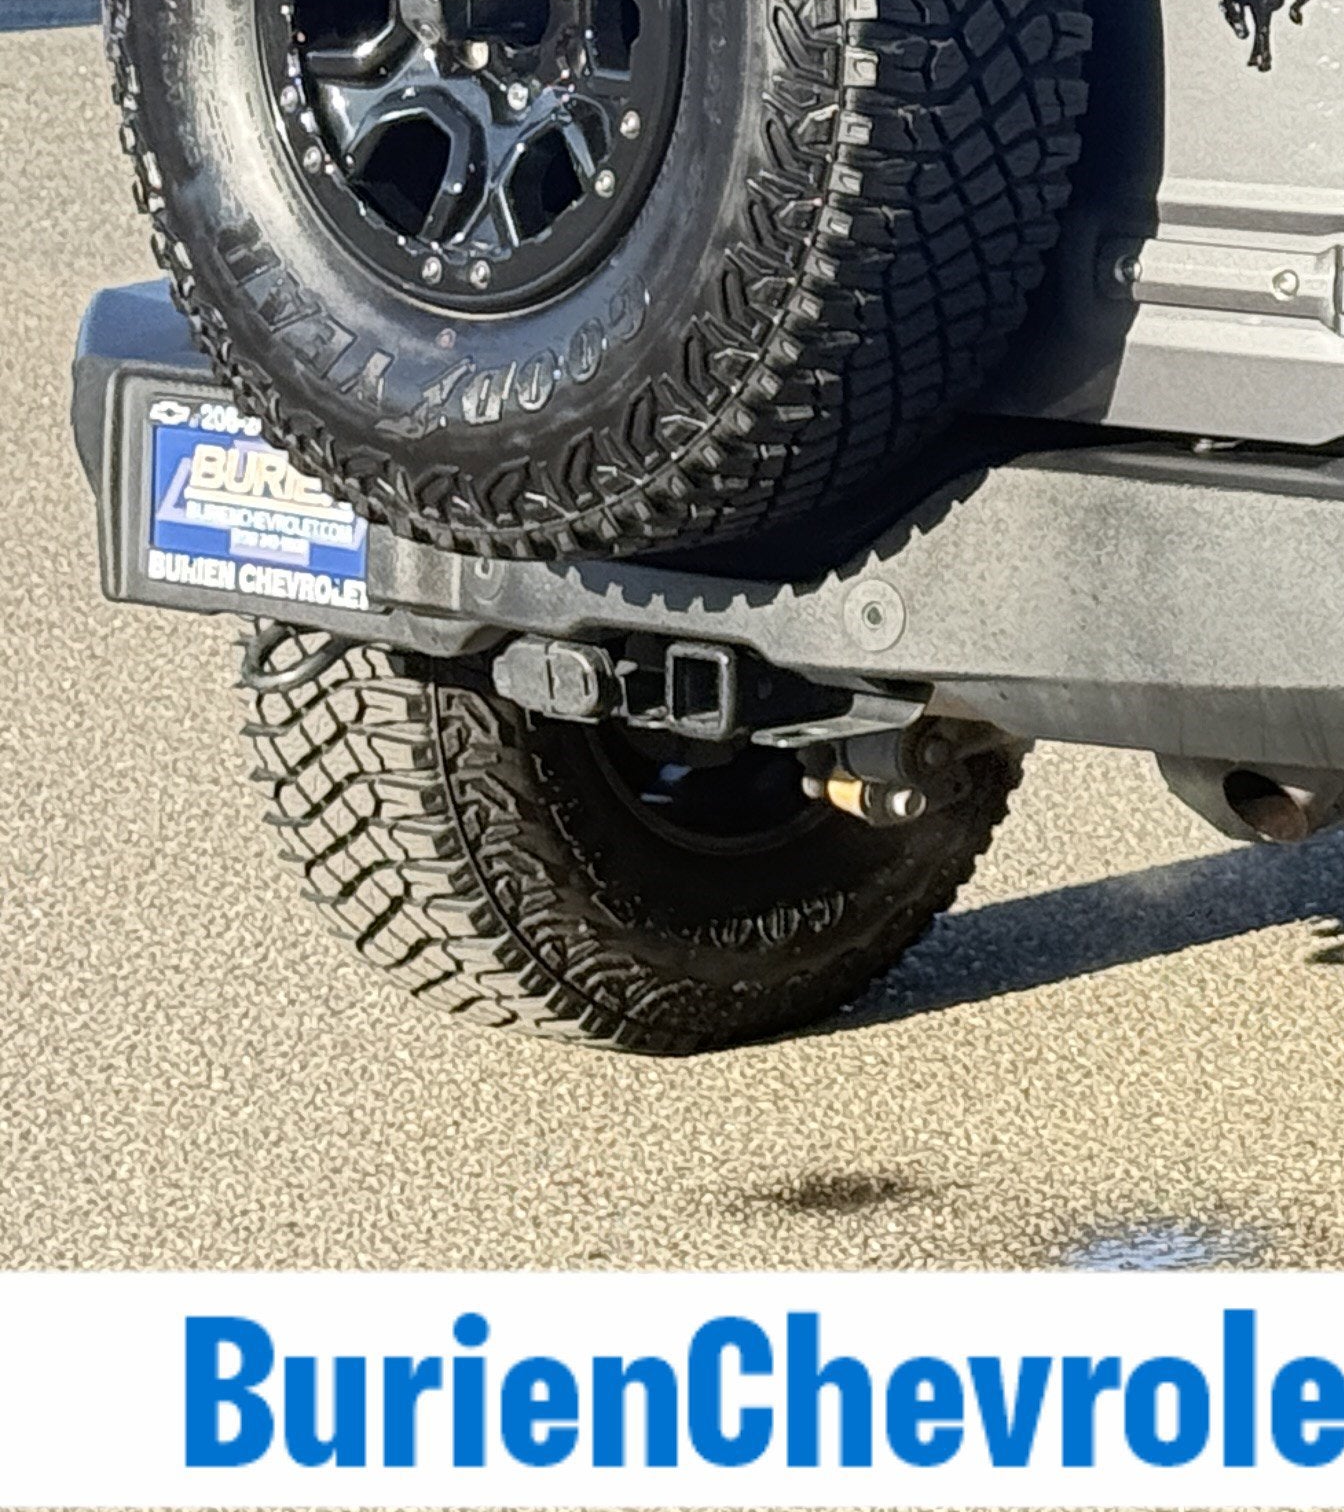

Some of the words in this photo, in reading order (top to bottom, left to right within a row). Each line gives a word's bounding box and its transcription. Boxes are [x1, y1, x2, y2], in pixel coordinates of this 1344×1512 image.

[190, 444, 352, 510] BURIE
[148, 549, 236, 591] BURIEN
[238, 563, 369, 610] CHEVROLET
